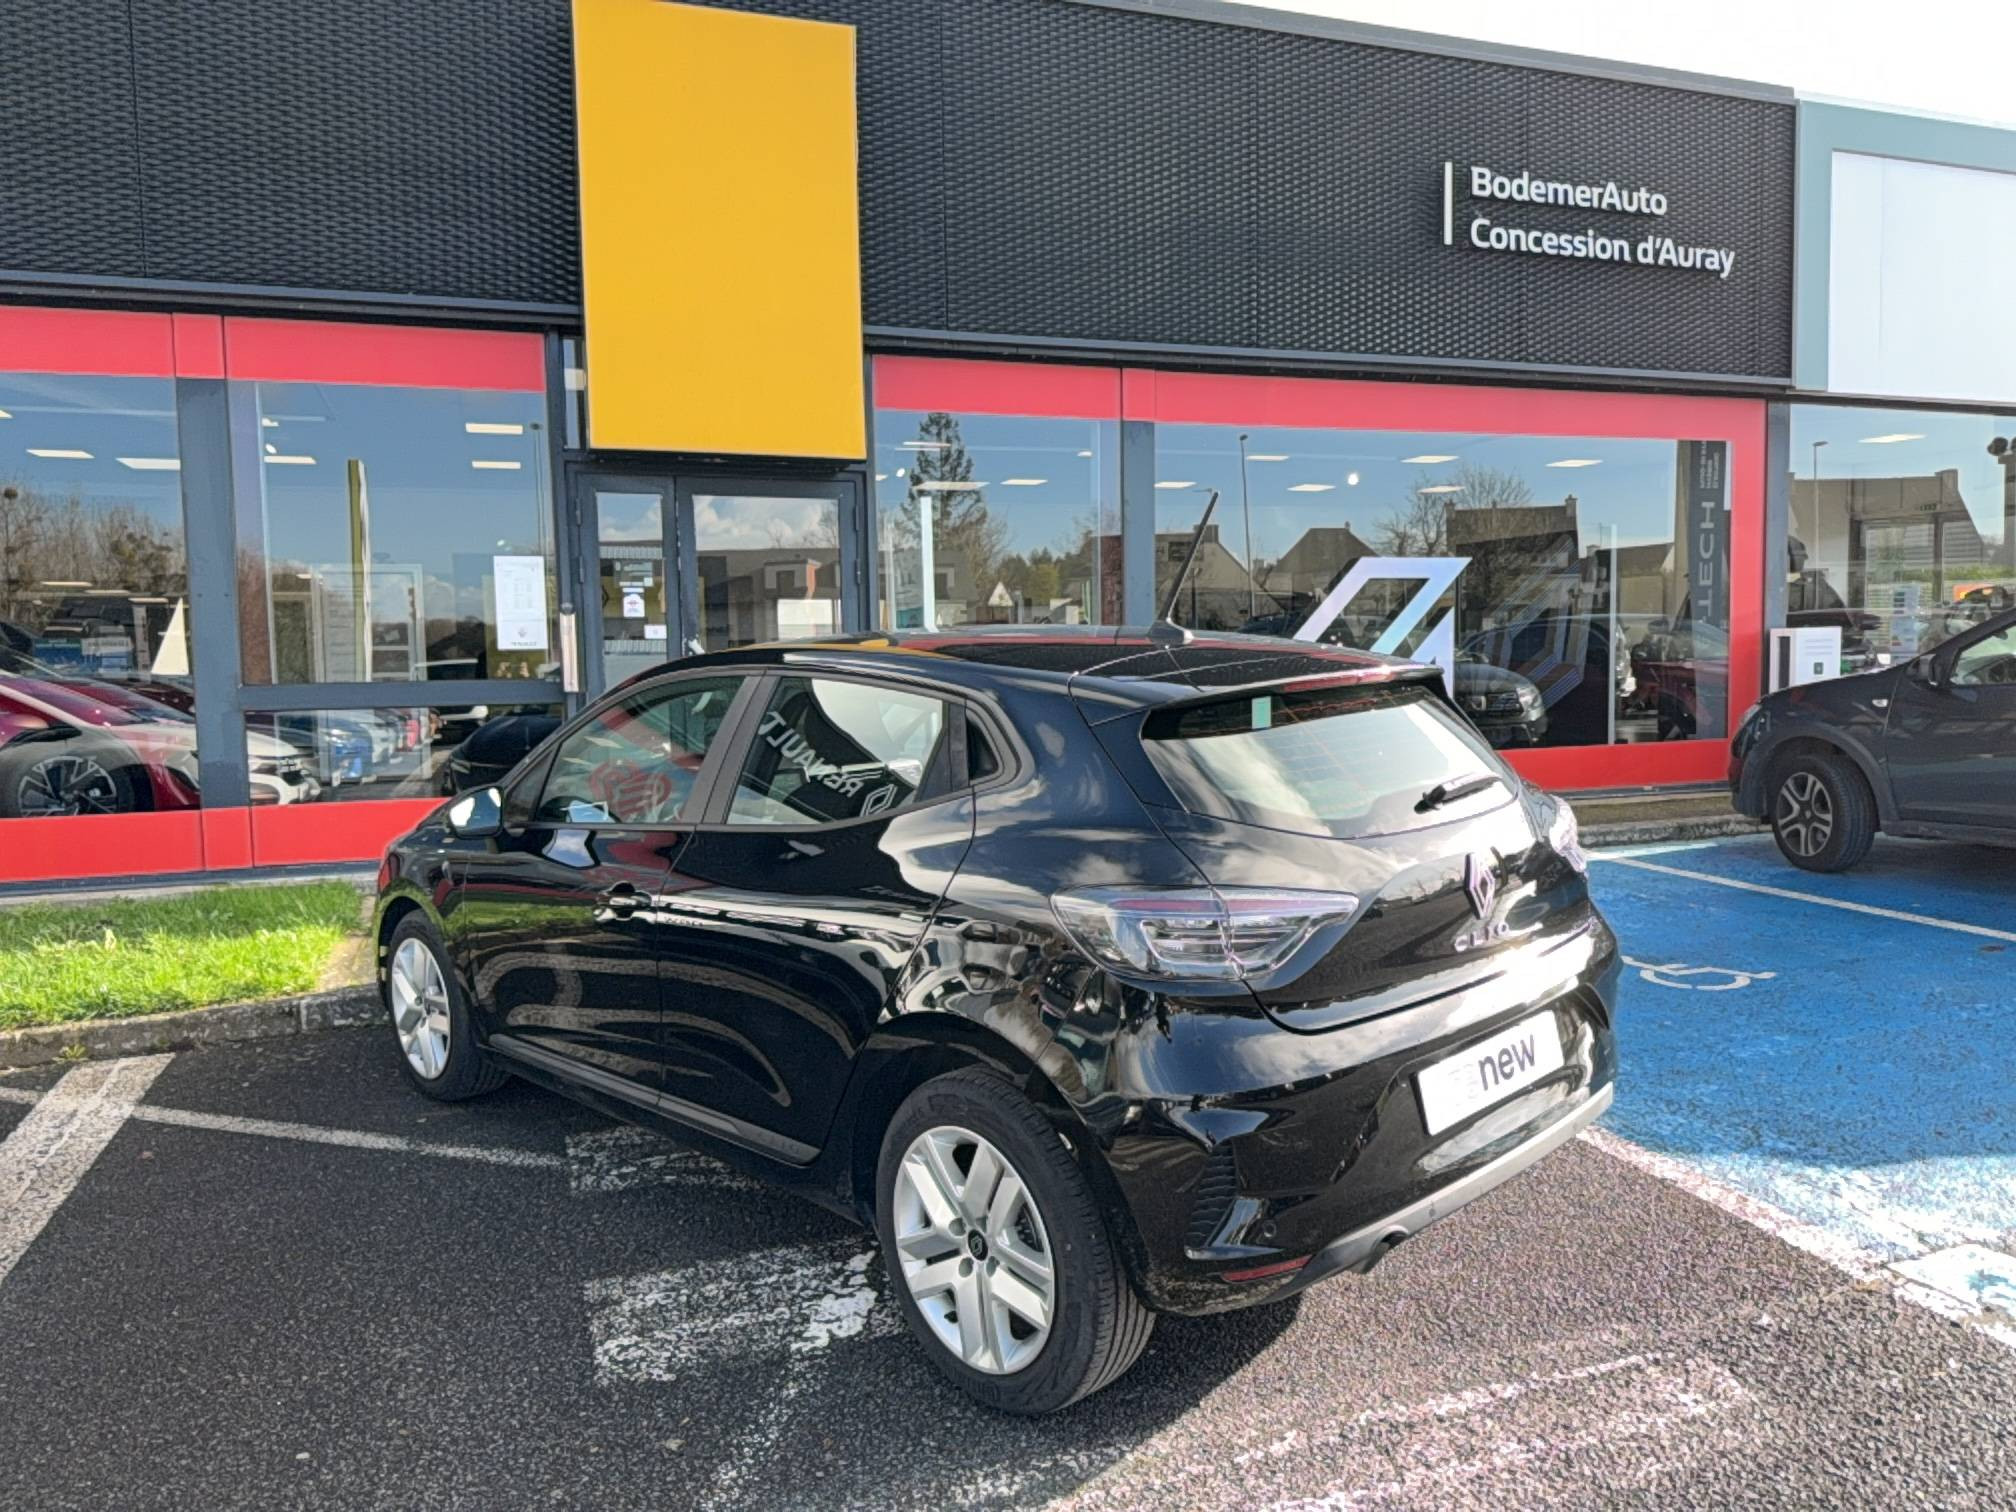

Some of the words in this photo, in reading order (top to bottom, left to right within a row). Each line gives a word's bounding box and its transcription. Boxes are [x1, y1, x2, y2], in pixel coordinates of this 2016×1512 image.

[1470, 165, 1668, 216] BodemerAuto
[1470, 218, 1631, 263] Concession
[1637, 235, 1736, 279] d'Auray
